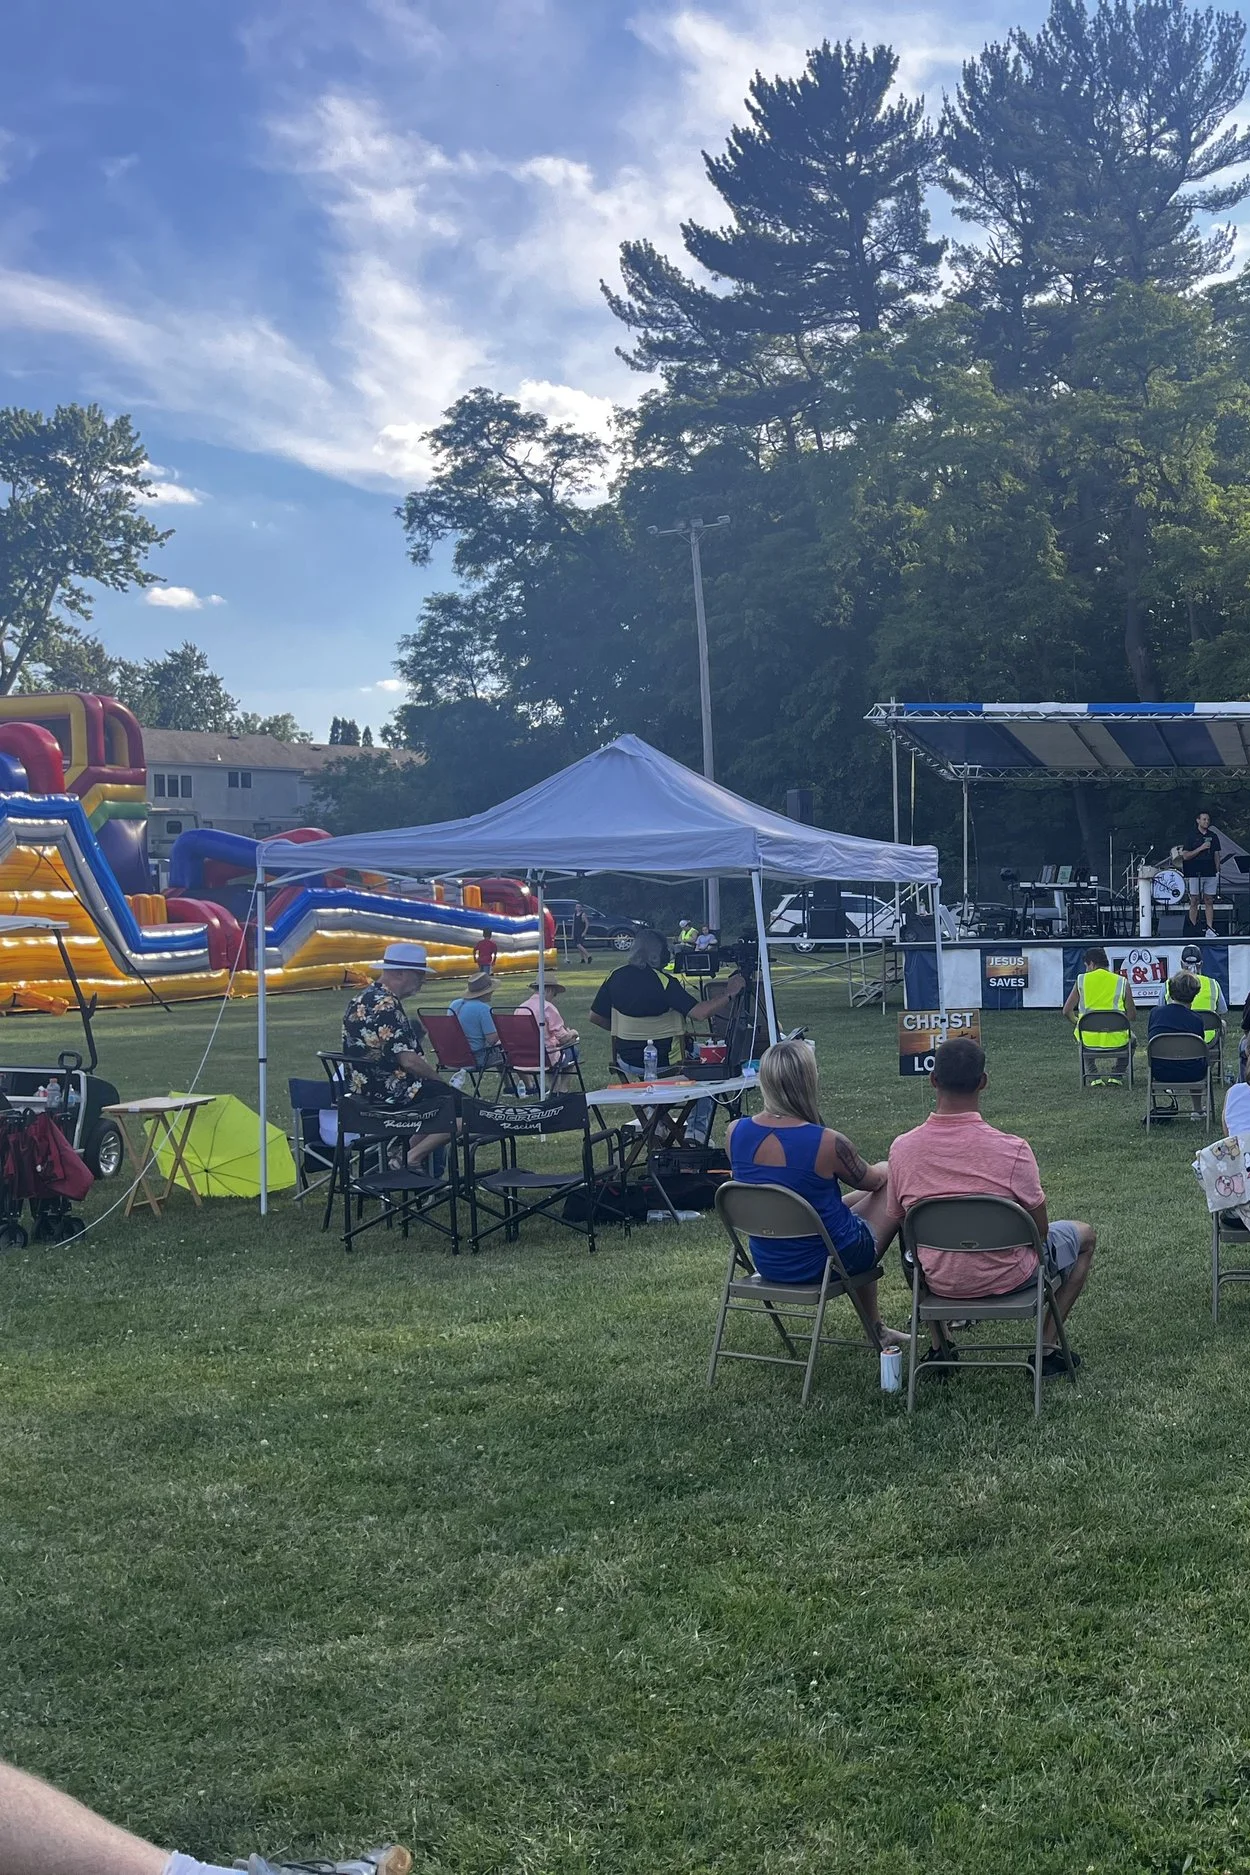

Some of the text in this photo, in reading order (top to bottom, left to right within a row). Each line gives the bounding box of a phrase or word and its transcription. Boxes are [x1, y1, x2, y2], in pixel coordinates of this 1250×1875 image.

[989, 957, 1024, 966] JESUS
[989, 978, 1025, 987] SAVES
[914, 1055, 936, 1071] LO
[506, 1105, 564, 1122] CIRCUIT
[383, 1120, 422, 1133] Racing
[500, 1122, 542, 1132] Racing
